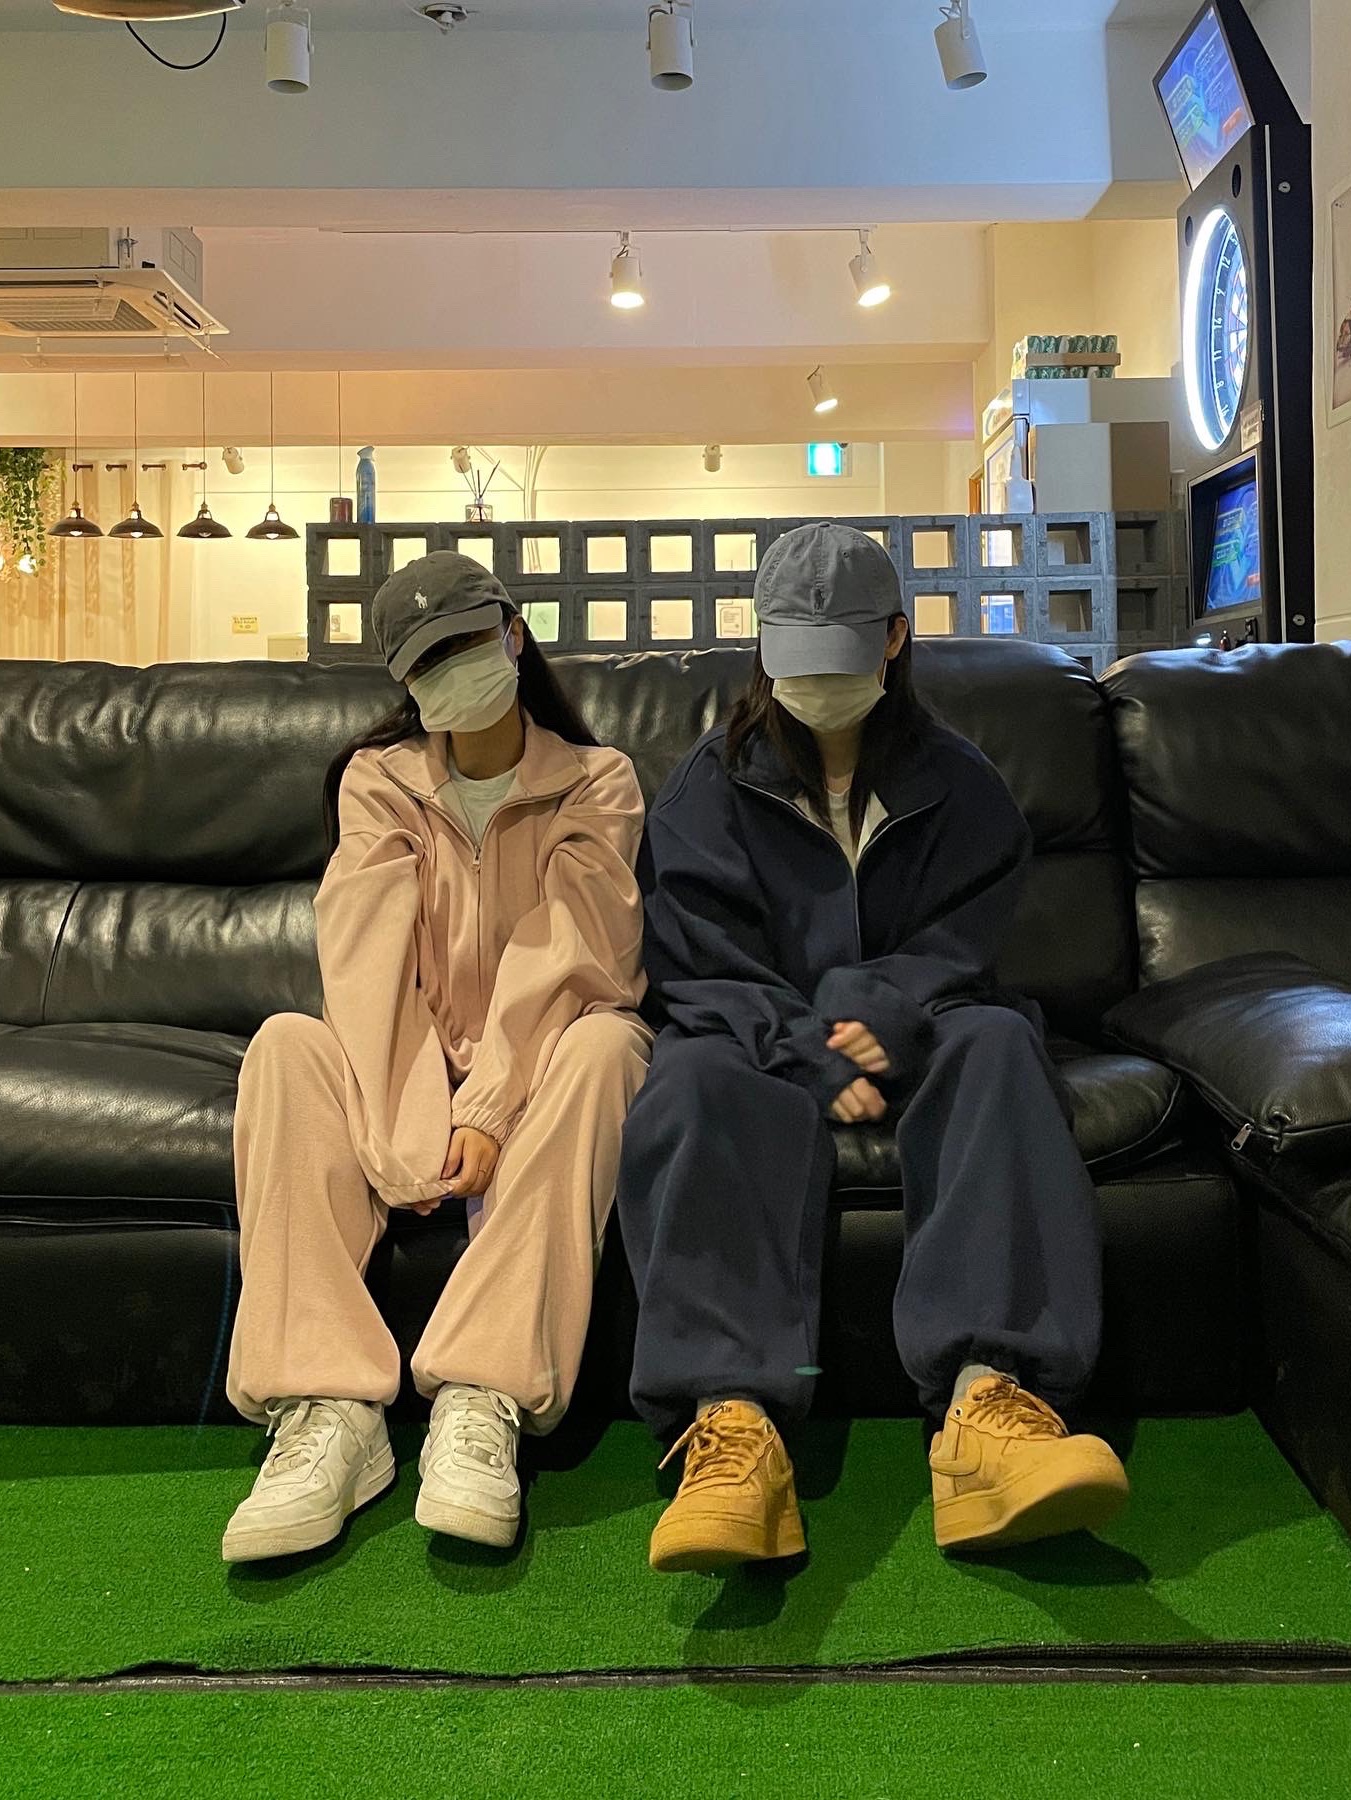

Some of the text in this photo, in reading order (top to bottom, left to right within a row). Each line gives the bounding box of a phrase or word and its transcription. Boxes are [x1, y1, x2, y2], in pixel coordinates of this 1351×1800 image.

[1222, 257, 1231, 269] 12
[1216, 288, 1226, 297] 9
[1213, 317, 1223, 329] 14
[1214, 349, 1222, 360] 11
[1216, 380, 1224, 389] 8
